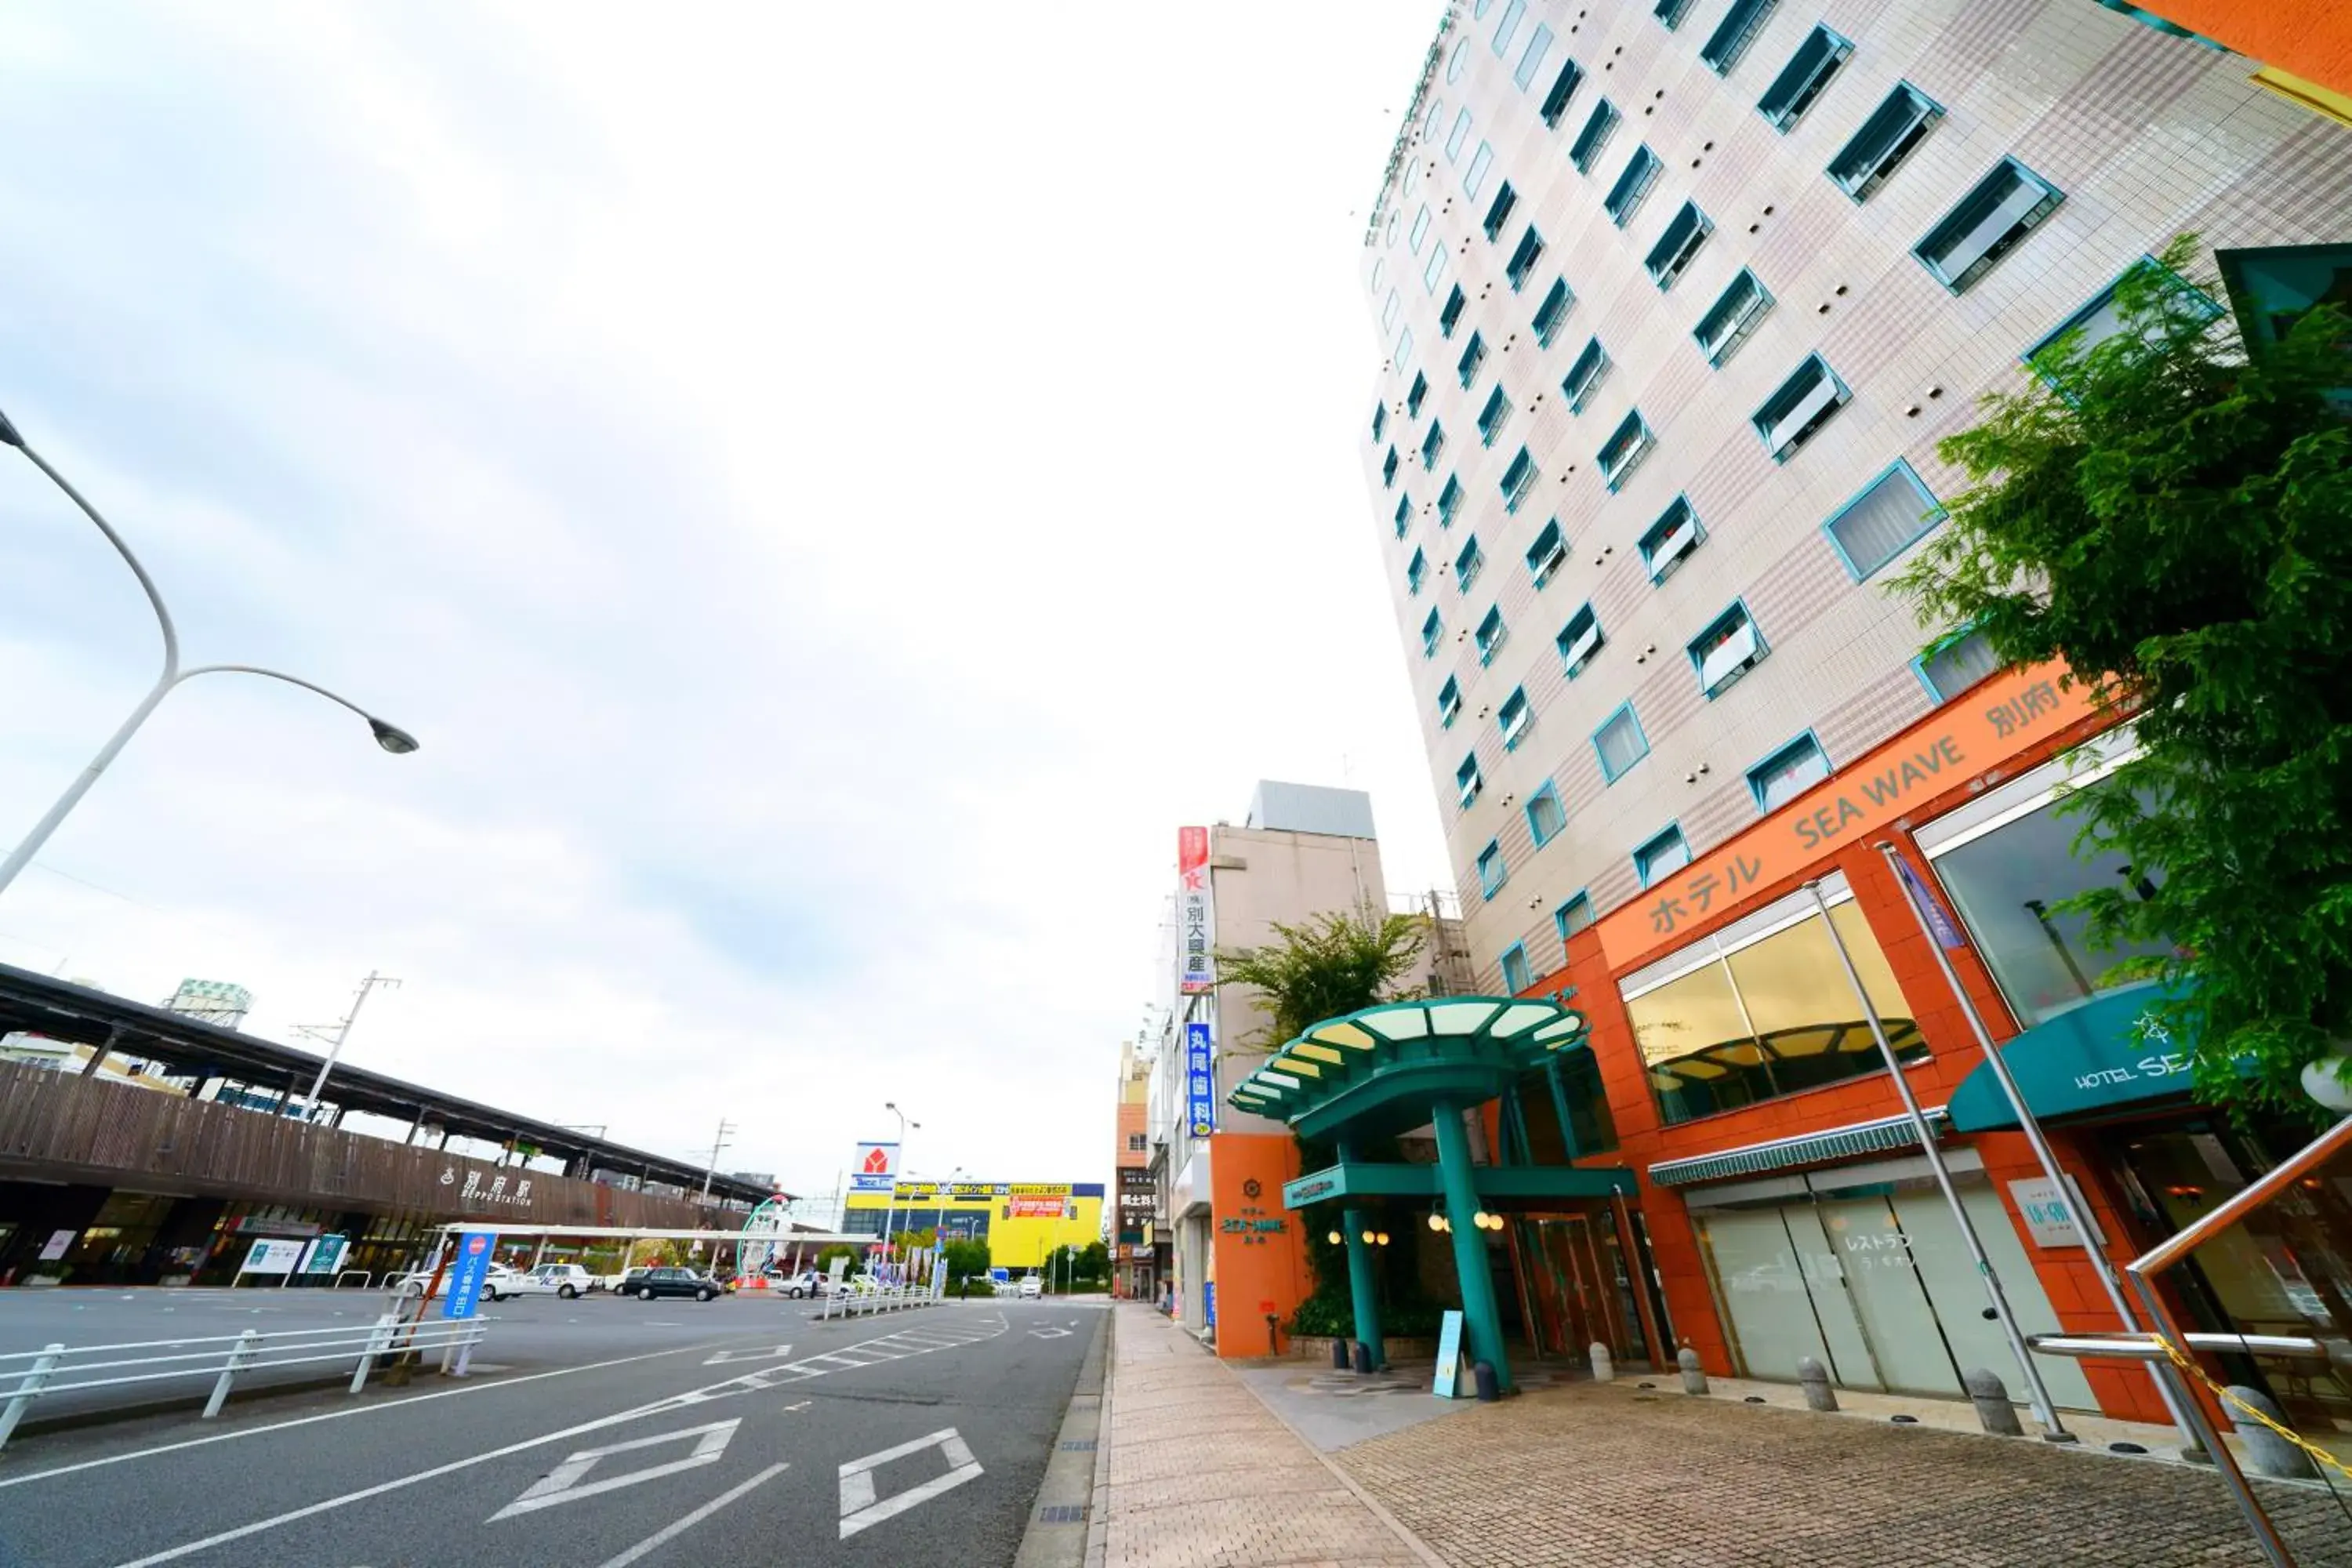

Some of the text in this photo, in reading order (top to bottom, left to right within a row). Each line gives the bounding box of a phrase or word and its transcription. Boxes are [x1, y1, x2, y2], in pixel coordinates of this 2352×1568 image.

[1650, 680, 2060, 933] ホテル SEA WAVE 別府
[1191, 1030, 1210, 1123] 丸尾歯科
[2074, 1067, 2138, 1089] HOTEL
[1845, 1233, 1913, 1252] レストラン
